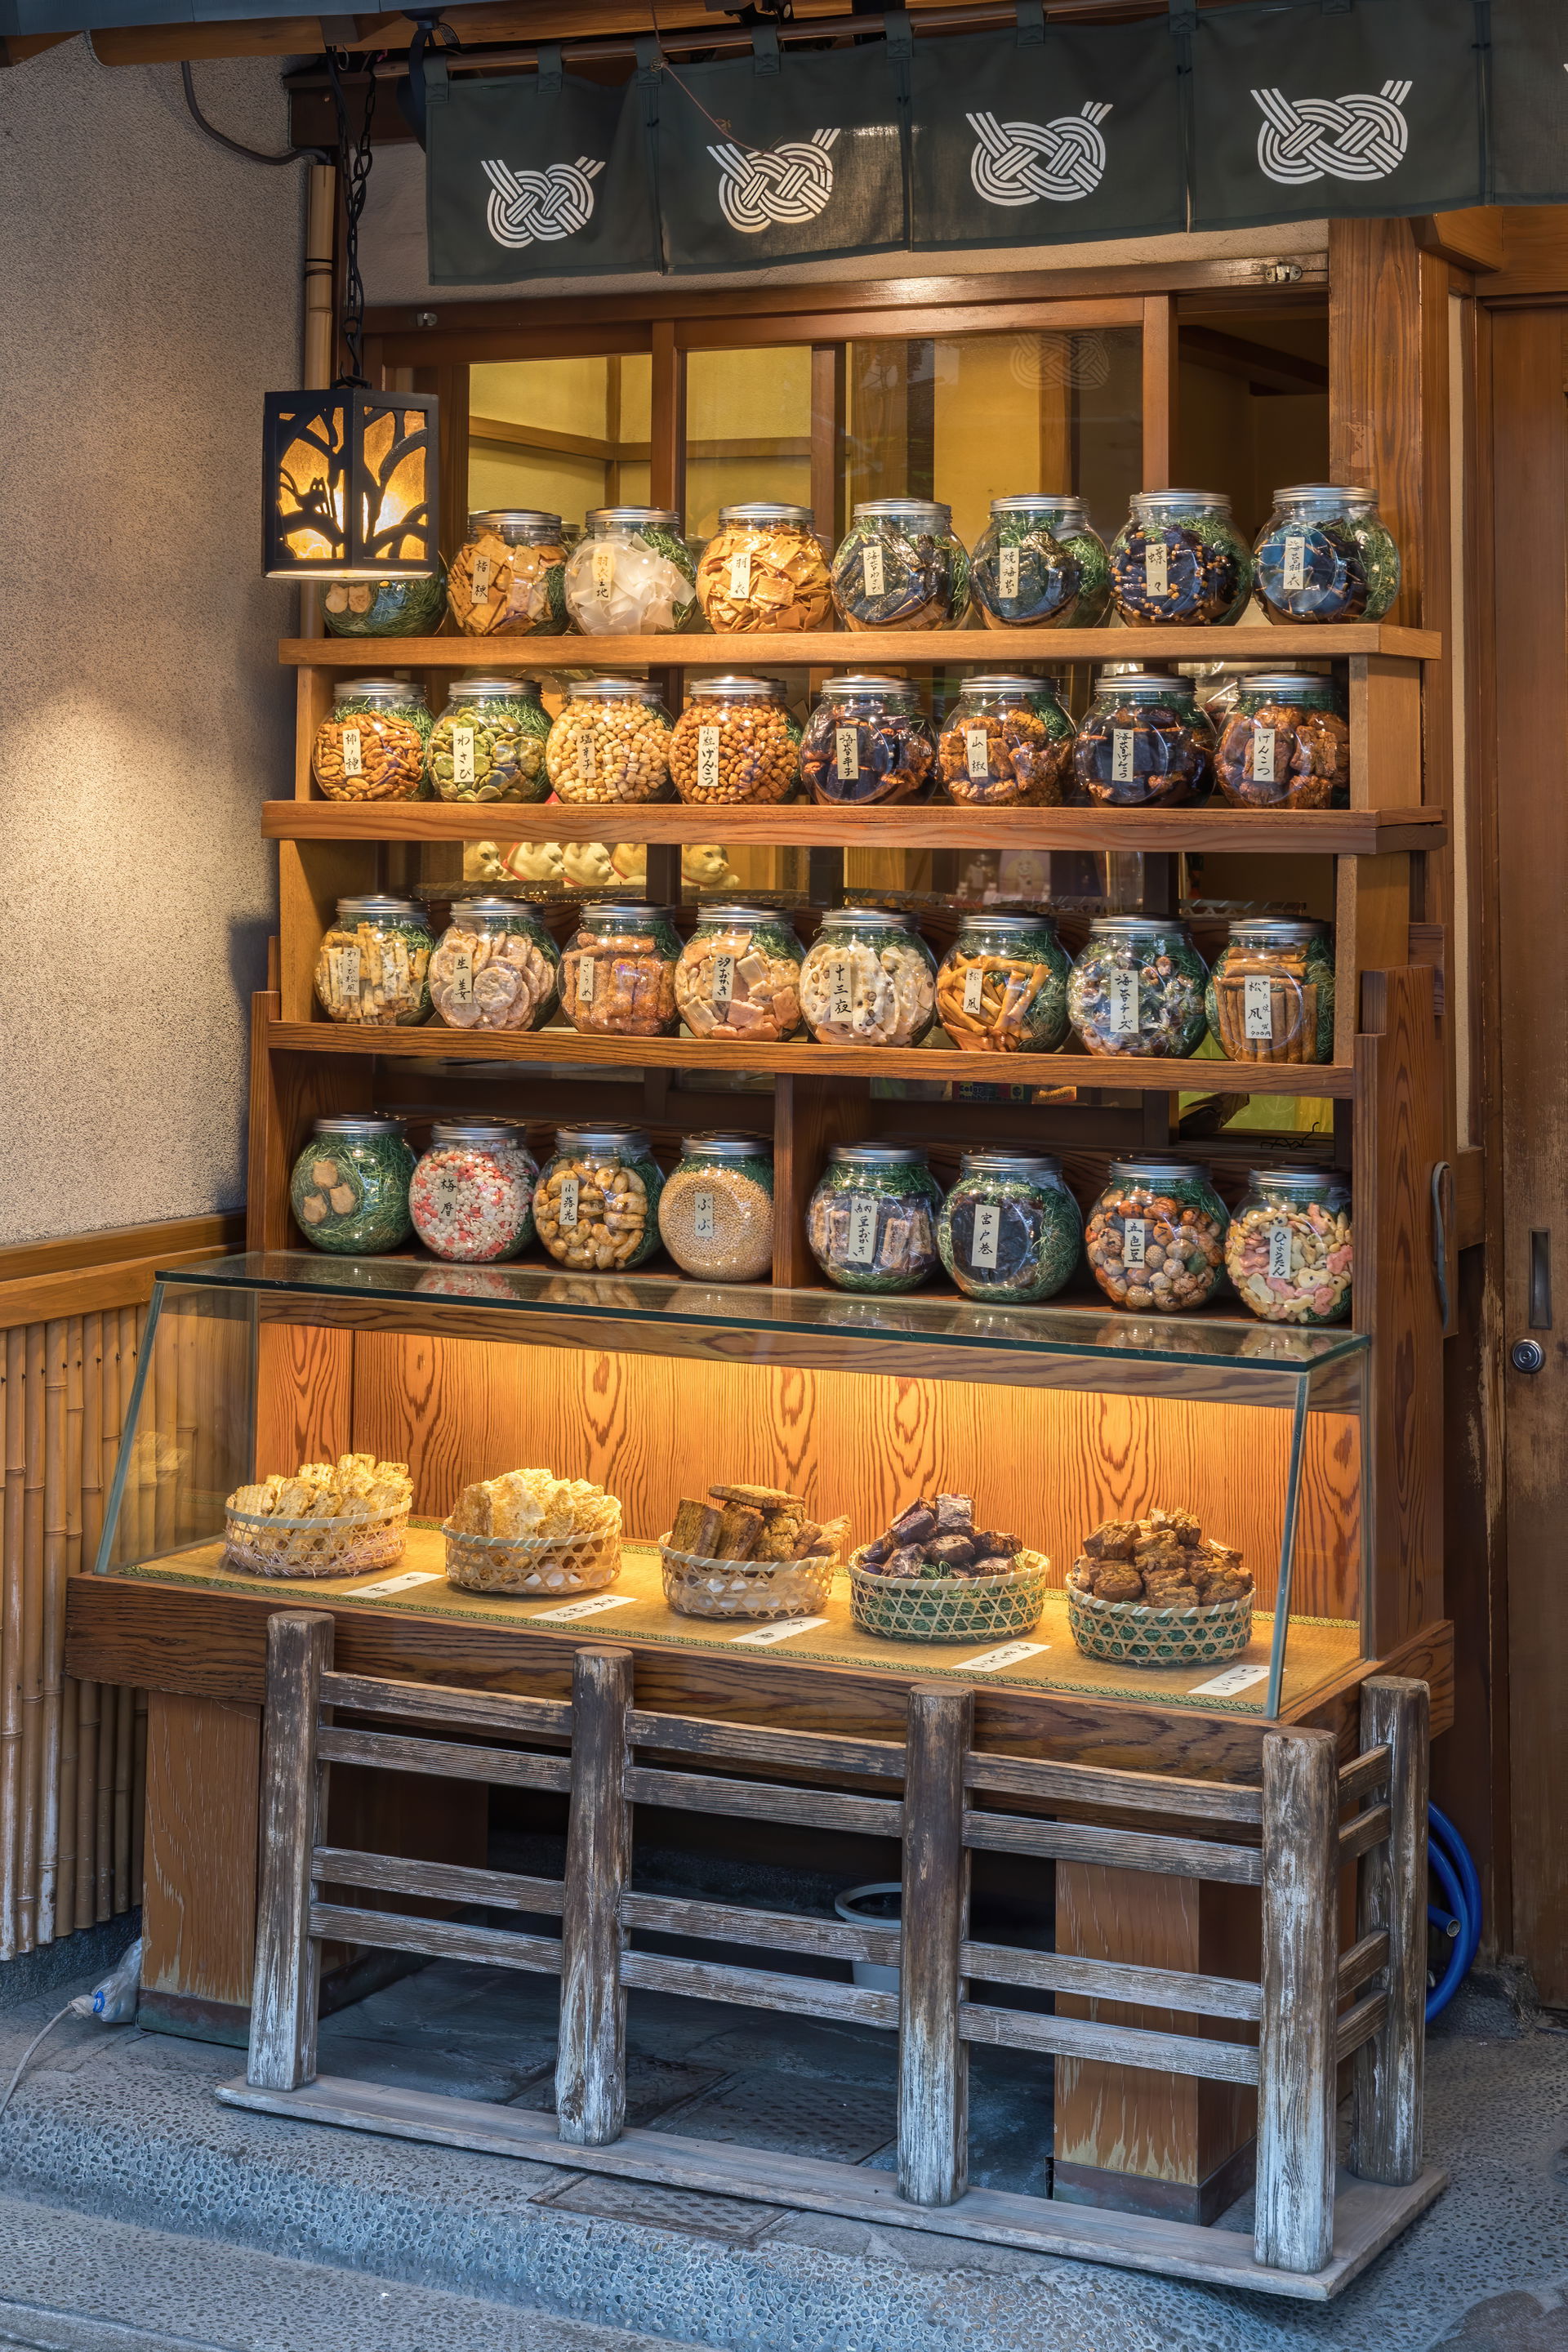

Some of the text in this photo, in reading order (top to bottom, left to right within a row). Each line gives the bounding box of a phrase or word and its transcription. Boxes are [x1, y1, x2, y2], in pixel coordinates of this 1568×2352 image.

[734, 558, 746, 595] 羽衣
[1003, 552, 1017, 595] 焼海苔
[1287, 541, 1302, 586] 海苔羽衣
[457, 735, 470, 779] わさび
[702, 728, 717, 785] 小粒げんこつ
[971, 737, 986, 772] 山椒
[1116, 733, 1131, 778] 海苔げんこつ
[1257, 733, 1272, 776] げんこつ
[346, 951, 357, 992] わさび松風
[455, 958, 470, 1000] 生姜
[581, 960, 592, 997] ざらめ
[717, 957, 730, 996] 汐おかき
[834, 964, 851, 1013] 十三夜
[968, 971, 979, 1011] 松風
[1115, 973, 1133, 1029] 海苔チーズ
[1248, 982, 1262, 1019] 松風
[698, 1198, 710, 1231] ぶぶ
[853, 1204, 872, 1256] 納豆おかき
[978, 1212, 992, 1254] 宮戸巻
[1126, 1222, 1143, 1262] 五色豆
[1273, 1232, 1286, 1276] ひょうたん
